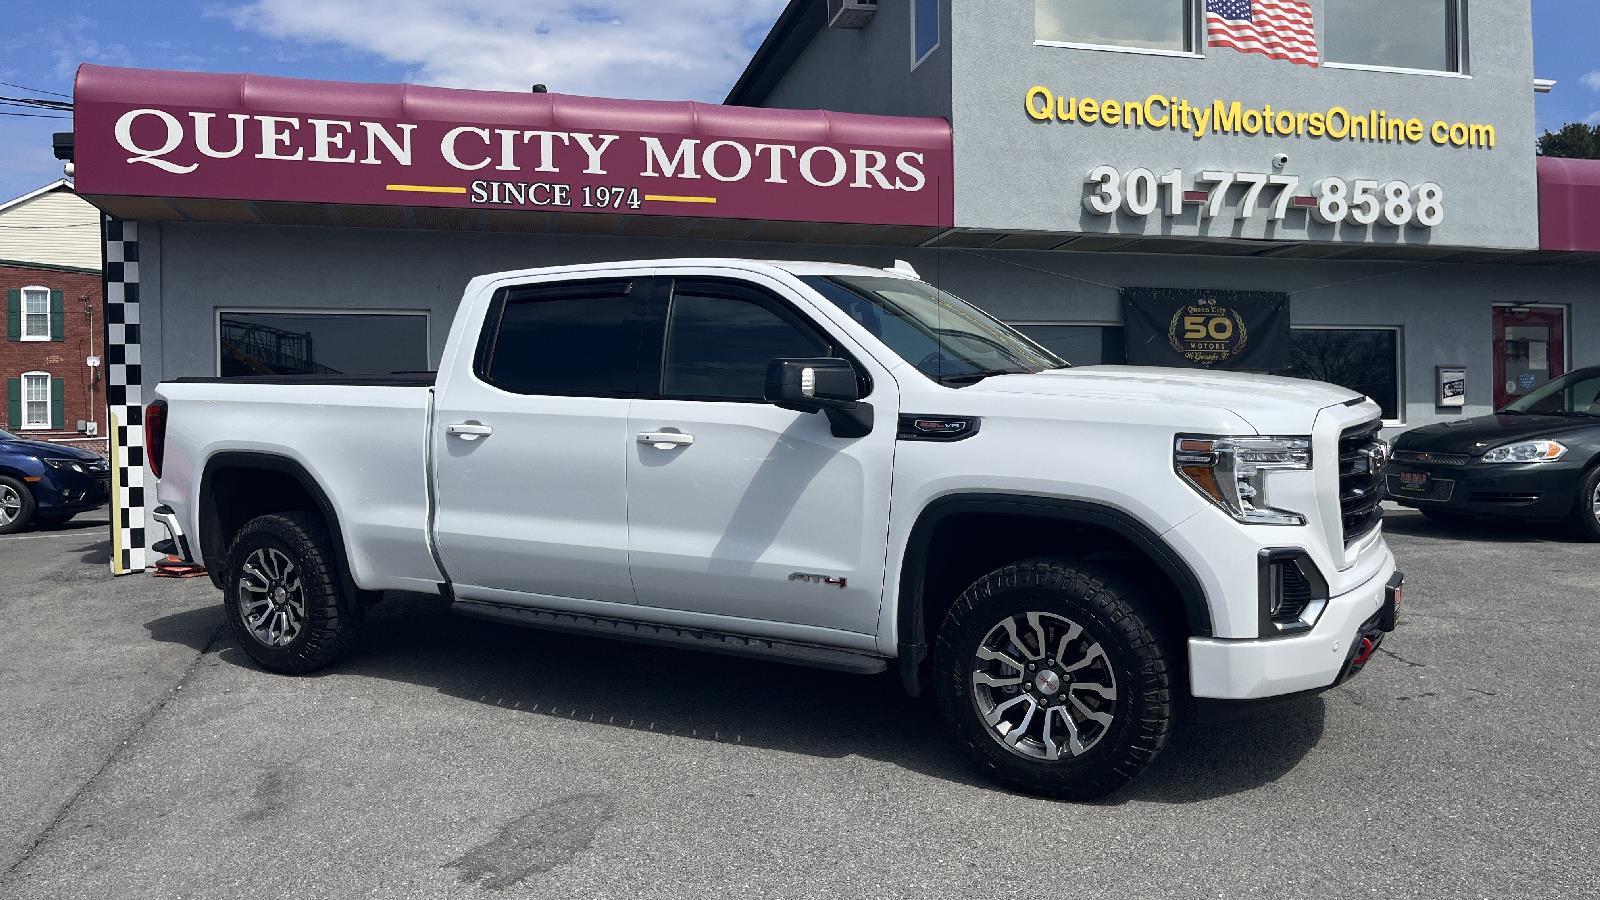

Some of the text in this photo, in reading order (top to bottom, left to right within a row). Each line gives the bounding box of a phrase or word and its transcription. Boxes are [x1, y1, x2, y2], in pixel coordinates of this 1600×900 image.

[1025, 85, 1495, 147] QueenCityMotorsOnline com
[114, 108, 926, 193] QUEEN CITY MOTORS
[470, 180, 642, 209] SINCE 1974
[1085, 163, 1445, 228] 301-777-8588
[1184, 316, 1233, 339] 50
[1190, 342, 1225, 350] MOTORS
[788, 571, 848, 588] AT4
